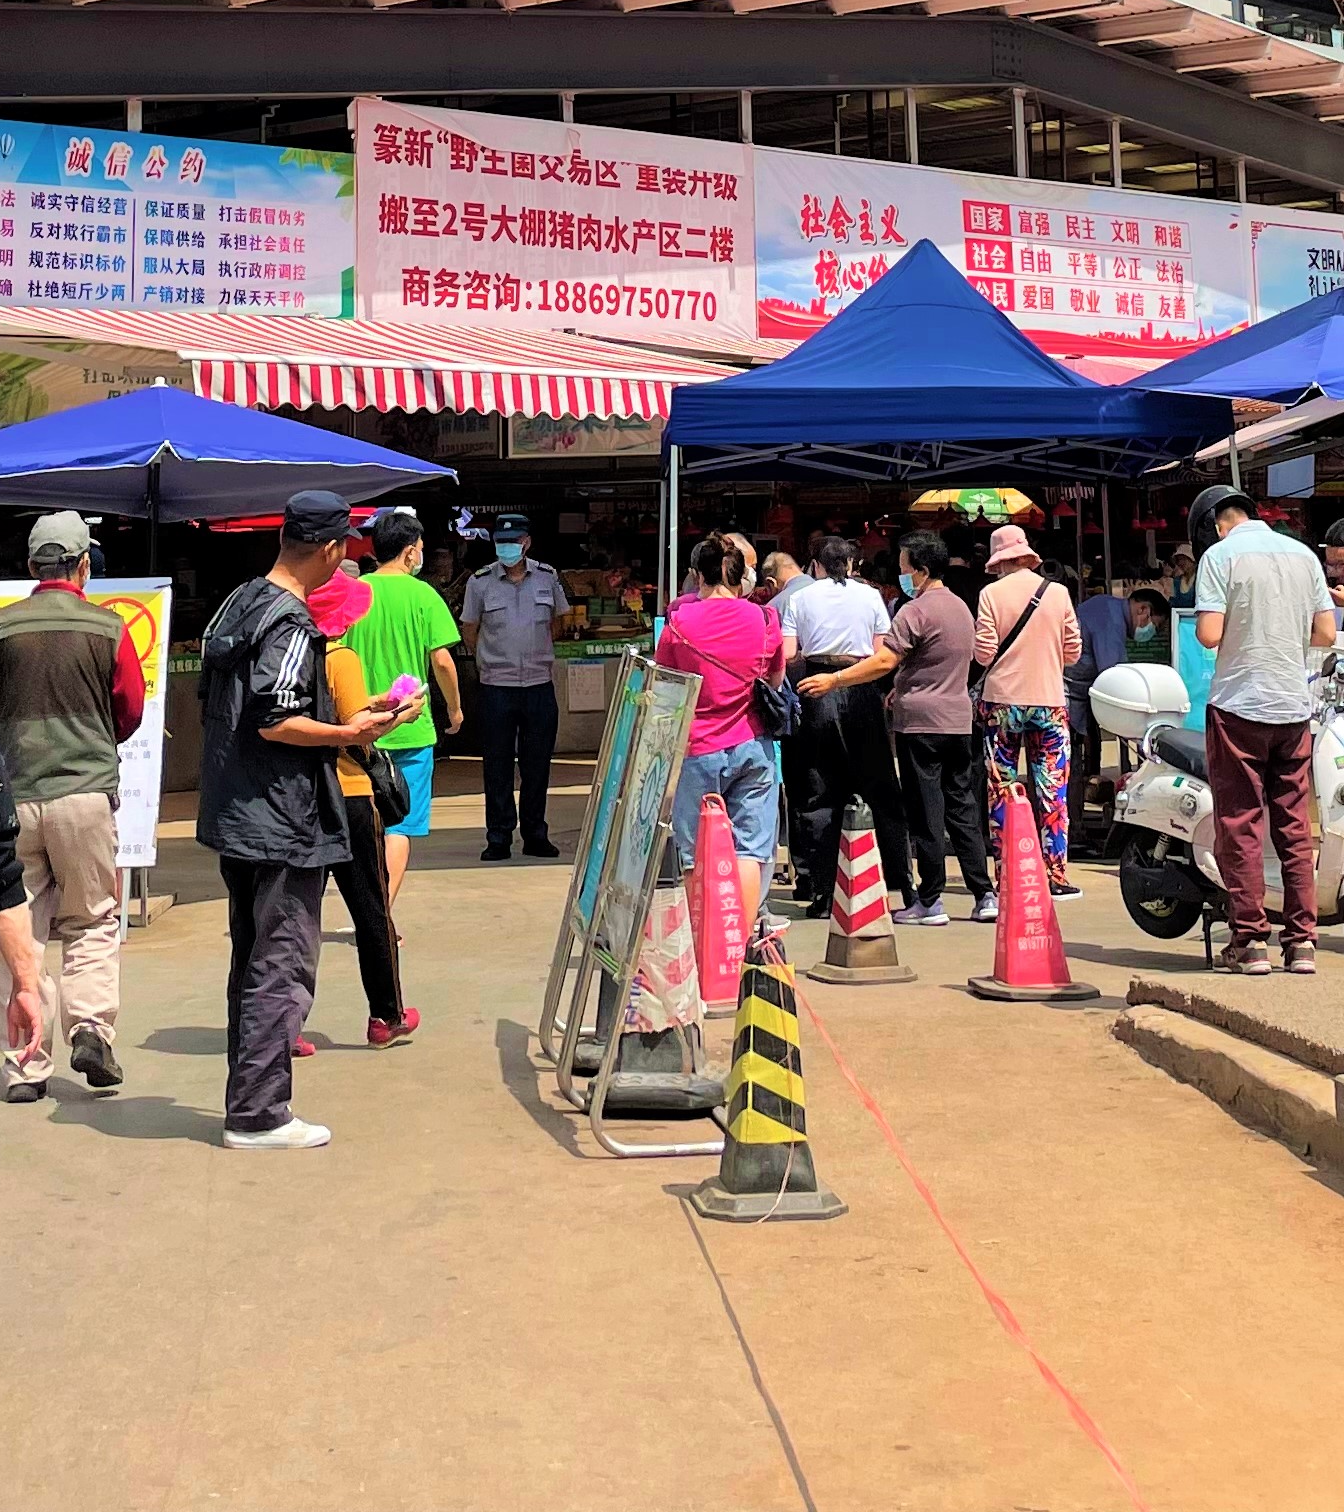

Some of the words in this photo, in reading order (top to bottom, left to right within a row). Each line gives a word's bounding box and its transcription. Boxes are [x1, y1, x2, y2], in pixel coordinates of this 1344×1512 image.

[66, 139, 206, 185] 诚信公约
[30, 191, 127, 216] 诚实守信经营
[144, 199, 206, 222] 保证质量
[218, 205, 306, 228] 打击假冒伪劣
[379, 193, 735, 263] 搬至2号大棚猪肉水产区二楼
[801, 194, 907, 245] 社会主义
[969, 205, 1005, 233] 国家
[1017, 209, 1050, 238] 富强
[1065, 213, 1096, 241] 民主
[1111, 218, 1140, 246] 文明
[1154, 222, 1182, 249] 和谐
[29, 221, 127, 245] 反对欺行霸市
[144, 228, 206, 250] 保障供给
[218, 232, 306, 254] 承担社会责任
[28, 250, 126, 274] 规范标识标价
[143, 257, 205, 278] 服从大局
[218, 260, 306, 282] 执行政府调控
[973, 243, 1007, 270] 社会
[1020, 246, 1051, 275] 自由
[1066, 251, 1098, 278] 平等
[1113, 255, 1142, 280] 公正
[1155, 258, 1184, 284] 法治
[27, 278, 126, 302] 杜绝短斤少两
[143, 285, 206, 306] 产销对接
[218, 289, 306, 310] 力保天天平价
[1023, 282, 1054, 311] 爱国
[1069, 286, 1101, 315] 敬业
[1114, 289, 1144, 317] 诚信
[1158, 293, 1187, 321] 友善
